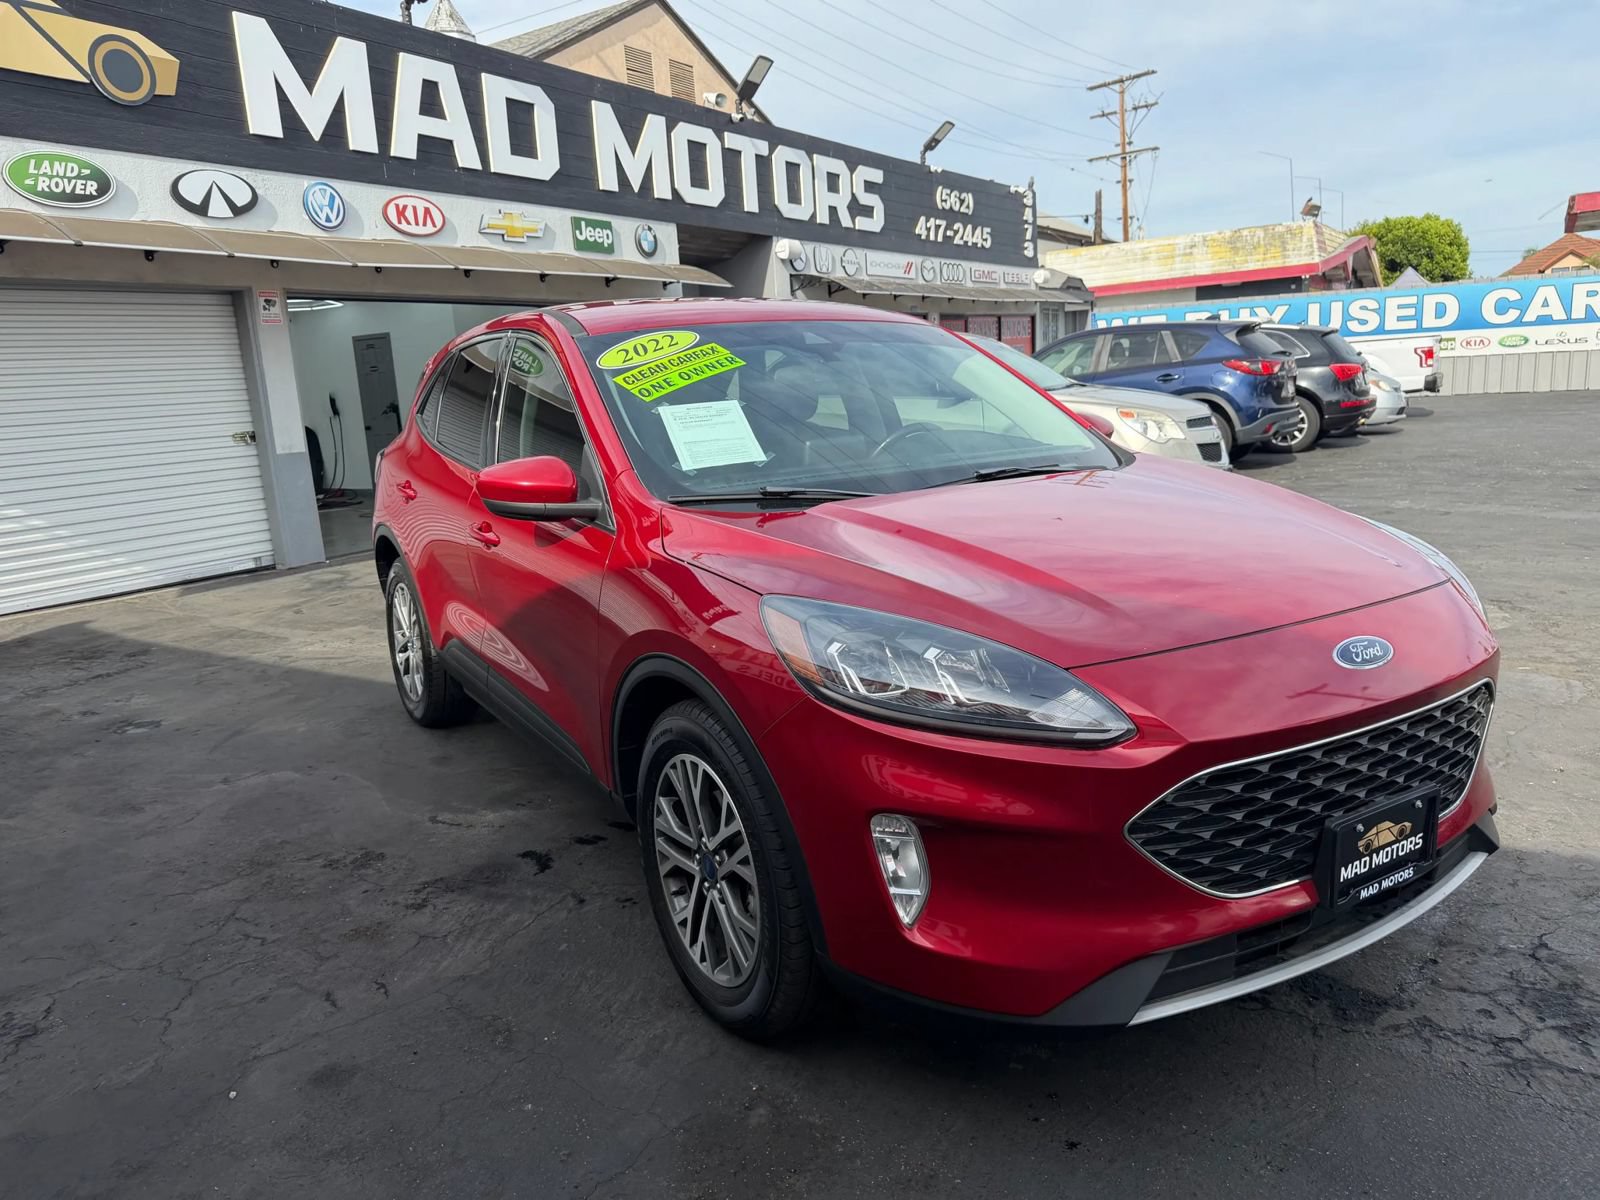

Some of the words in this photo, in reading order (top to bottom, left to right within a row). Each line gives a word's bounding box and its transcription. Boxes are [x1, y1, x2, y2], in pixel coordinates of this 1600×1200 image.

[231, 10, 562, 182] MAD
[591, 100, 885, 233] MOTORS
[29, 158, 79, 178] LAND
[37, 177, 98, 196] ROVER
[936, 185, 974, 215] (562)
[394, 203, 437, 229] KIA
[576, 221, 613, 247] Jeep
[915, 215, 992, 249] 417-2445
[973, 269, 998, 281] GMC
[1306, 293, 1460, 334] USED
[1480, 281, 1600, 325] CAR
[616, 334, 679, 364] 2022
[1465, 338, 1486, 347] KIA
[1535, 336, 1588, 345] LEXUS
[622, 362, 669, 386] CLEAN
[669, 345, 720, 368] CARFAX
[638, 377, 675, 398] ONE
[678, 356, 737, 381] OWNER
[1349, 641, 1384, 662] Ford
[1340, 856, 1370, 882] MAD
[1371, 832, 1424, 869] MOTORS
[1360, 883, 1379, 900] MAD
[1380, 867, 1414, 890] MOTORS
